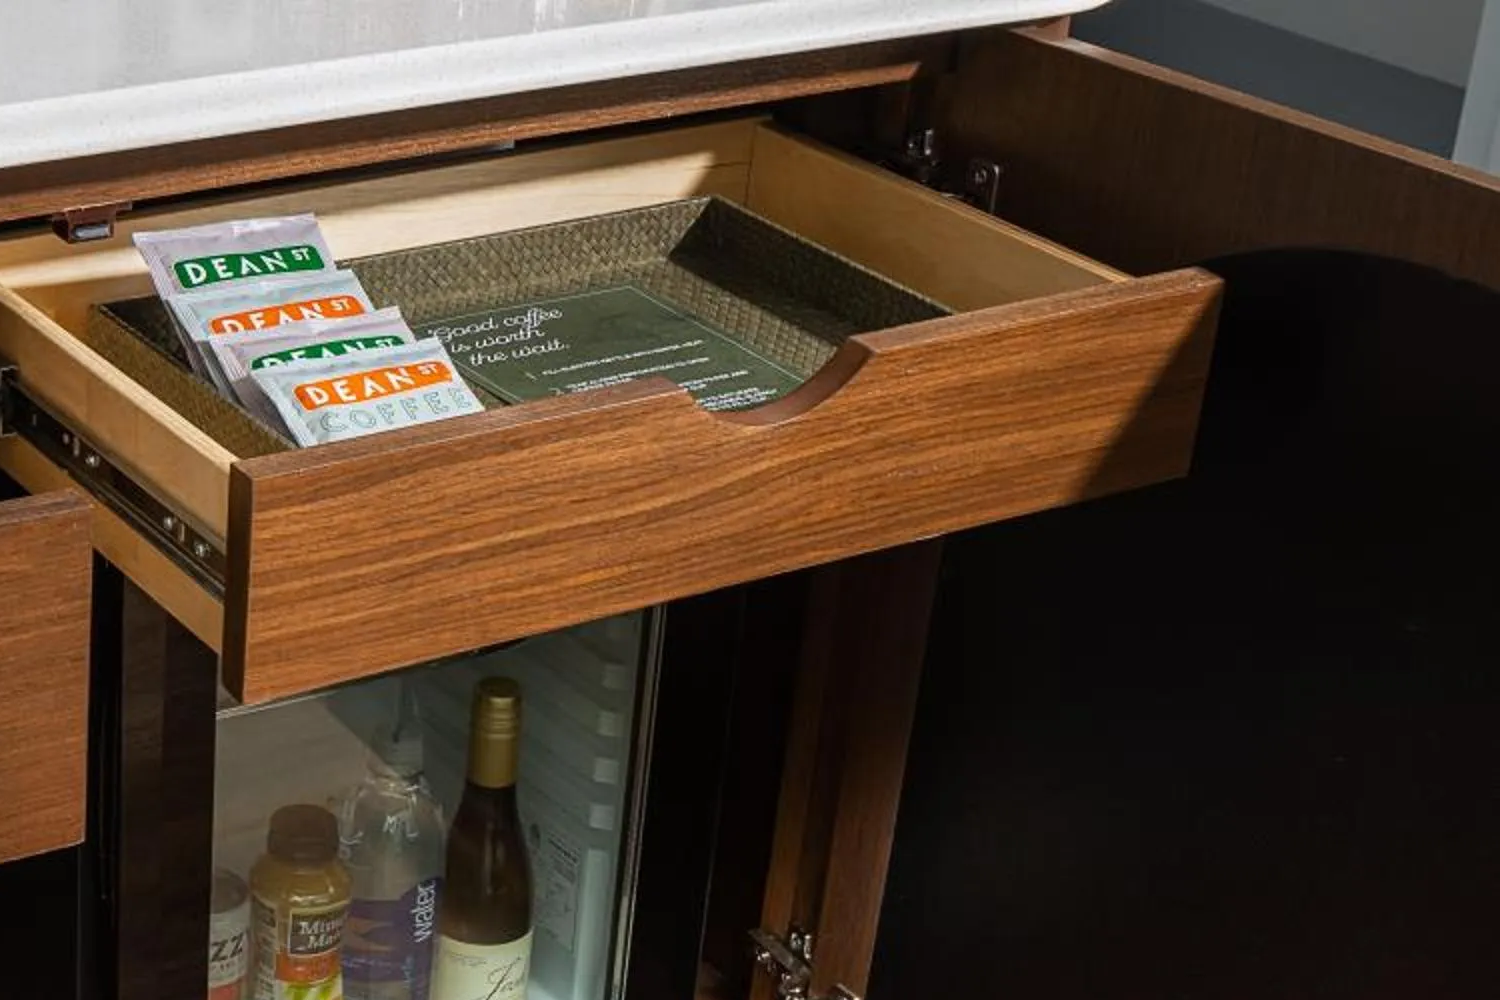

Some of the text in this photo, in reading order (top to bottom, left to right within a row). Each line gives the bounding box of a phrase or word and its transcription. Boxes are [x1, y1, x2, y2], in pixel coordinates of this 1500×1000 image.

[183, 248, 310, 285] DEAN ST
[331, 299, 350, 311] ST
[503, 307, 563, 328] coffee
[469, 352, 509, 366] the
[305, 363, 438, 405] DEAN ST
[320, 388, 472, 433] COFFEE
